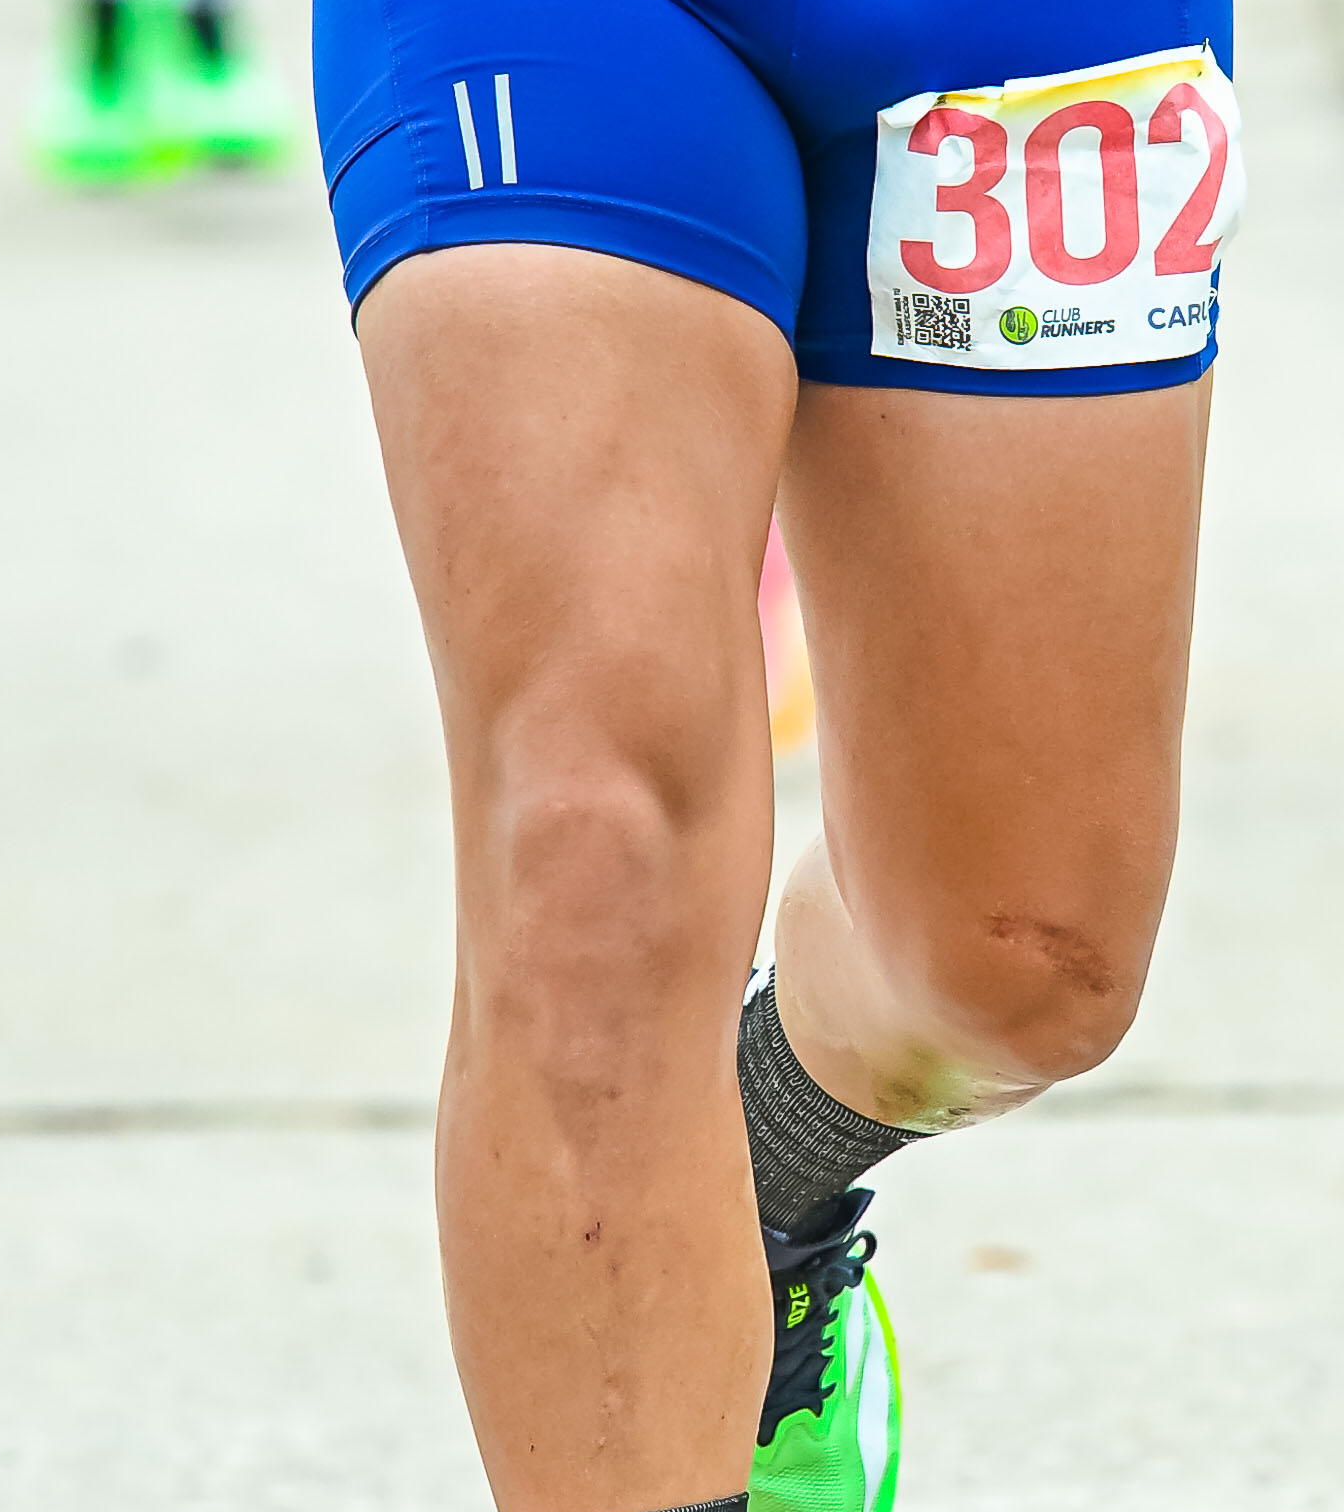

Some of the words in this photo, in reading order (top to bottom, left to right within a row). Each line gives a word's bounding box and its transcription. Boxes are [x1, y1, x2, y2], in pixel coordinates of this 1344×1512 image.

[899, 81, 1229, 294] 302
[1042, 307, 1081, 324] CLUB
[1040, 319, 1115, 339] RUNNER'S
